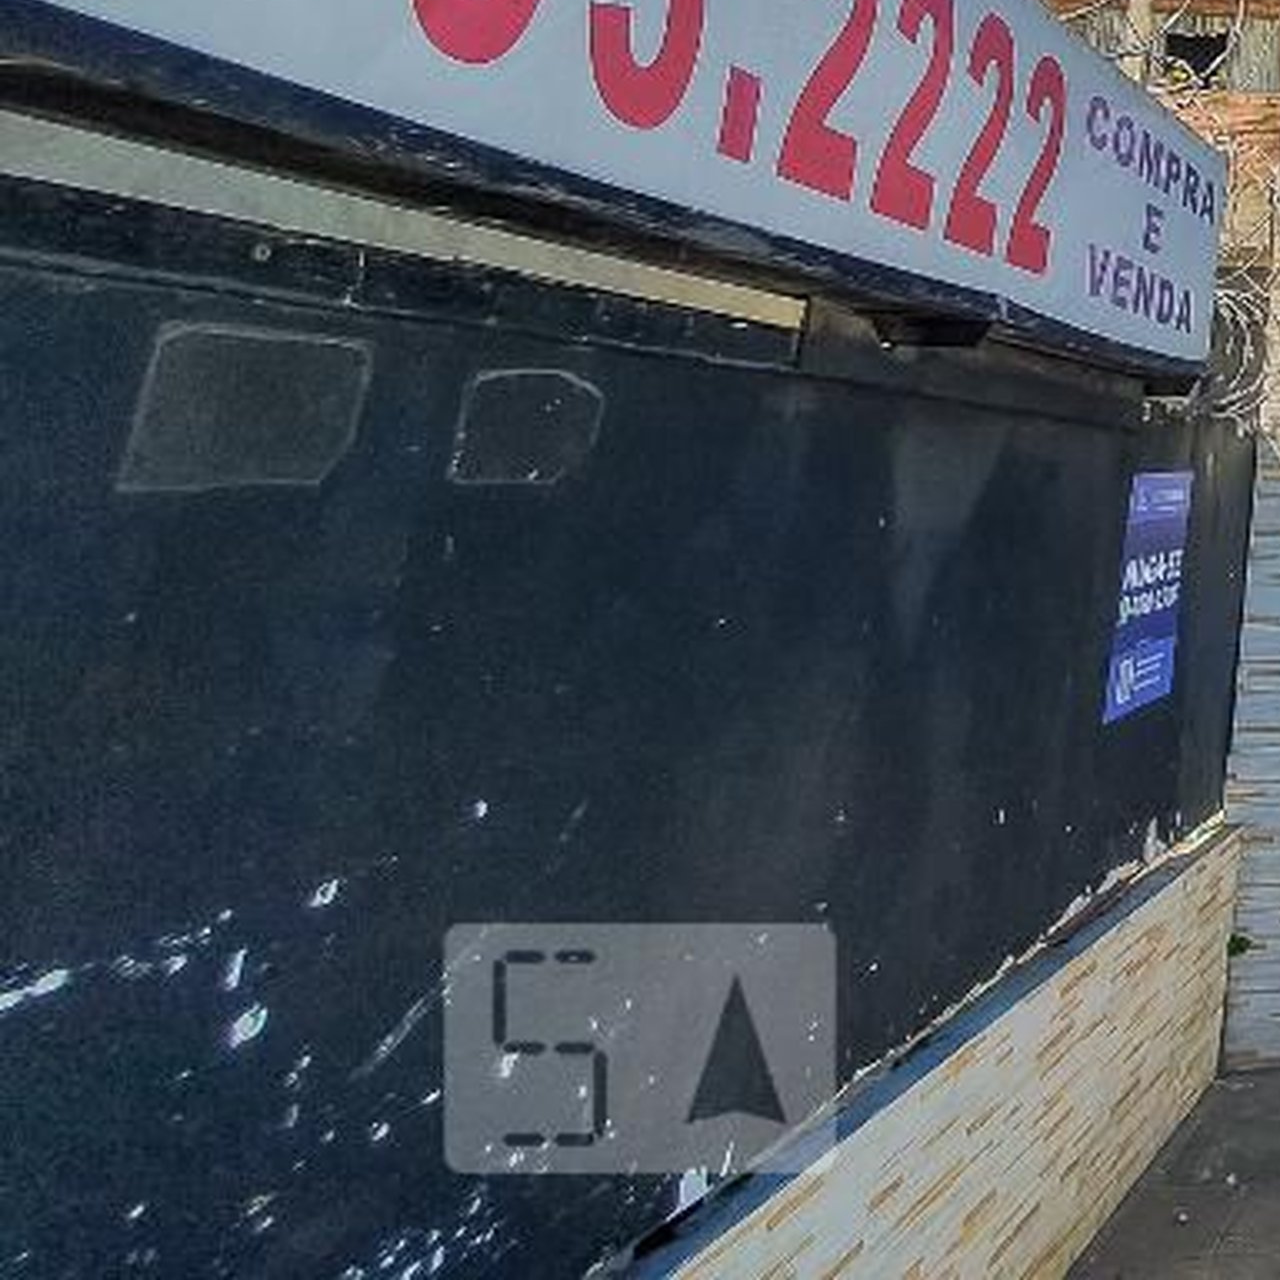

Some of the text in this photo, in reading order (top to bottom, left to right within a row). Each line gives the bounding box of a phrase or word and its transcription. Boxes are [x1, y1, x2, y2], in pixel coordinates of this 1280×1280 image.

[1086, 96, 1214, 224] COMPRA
[1143, 203, 1163, 253] E
[1088, 244, 1191, 334] VENDA
